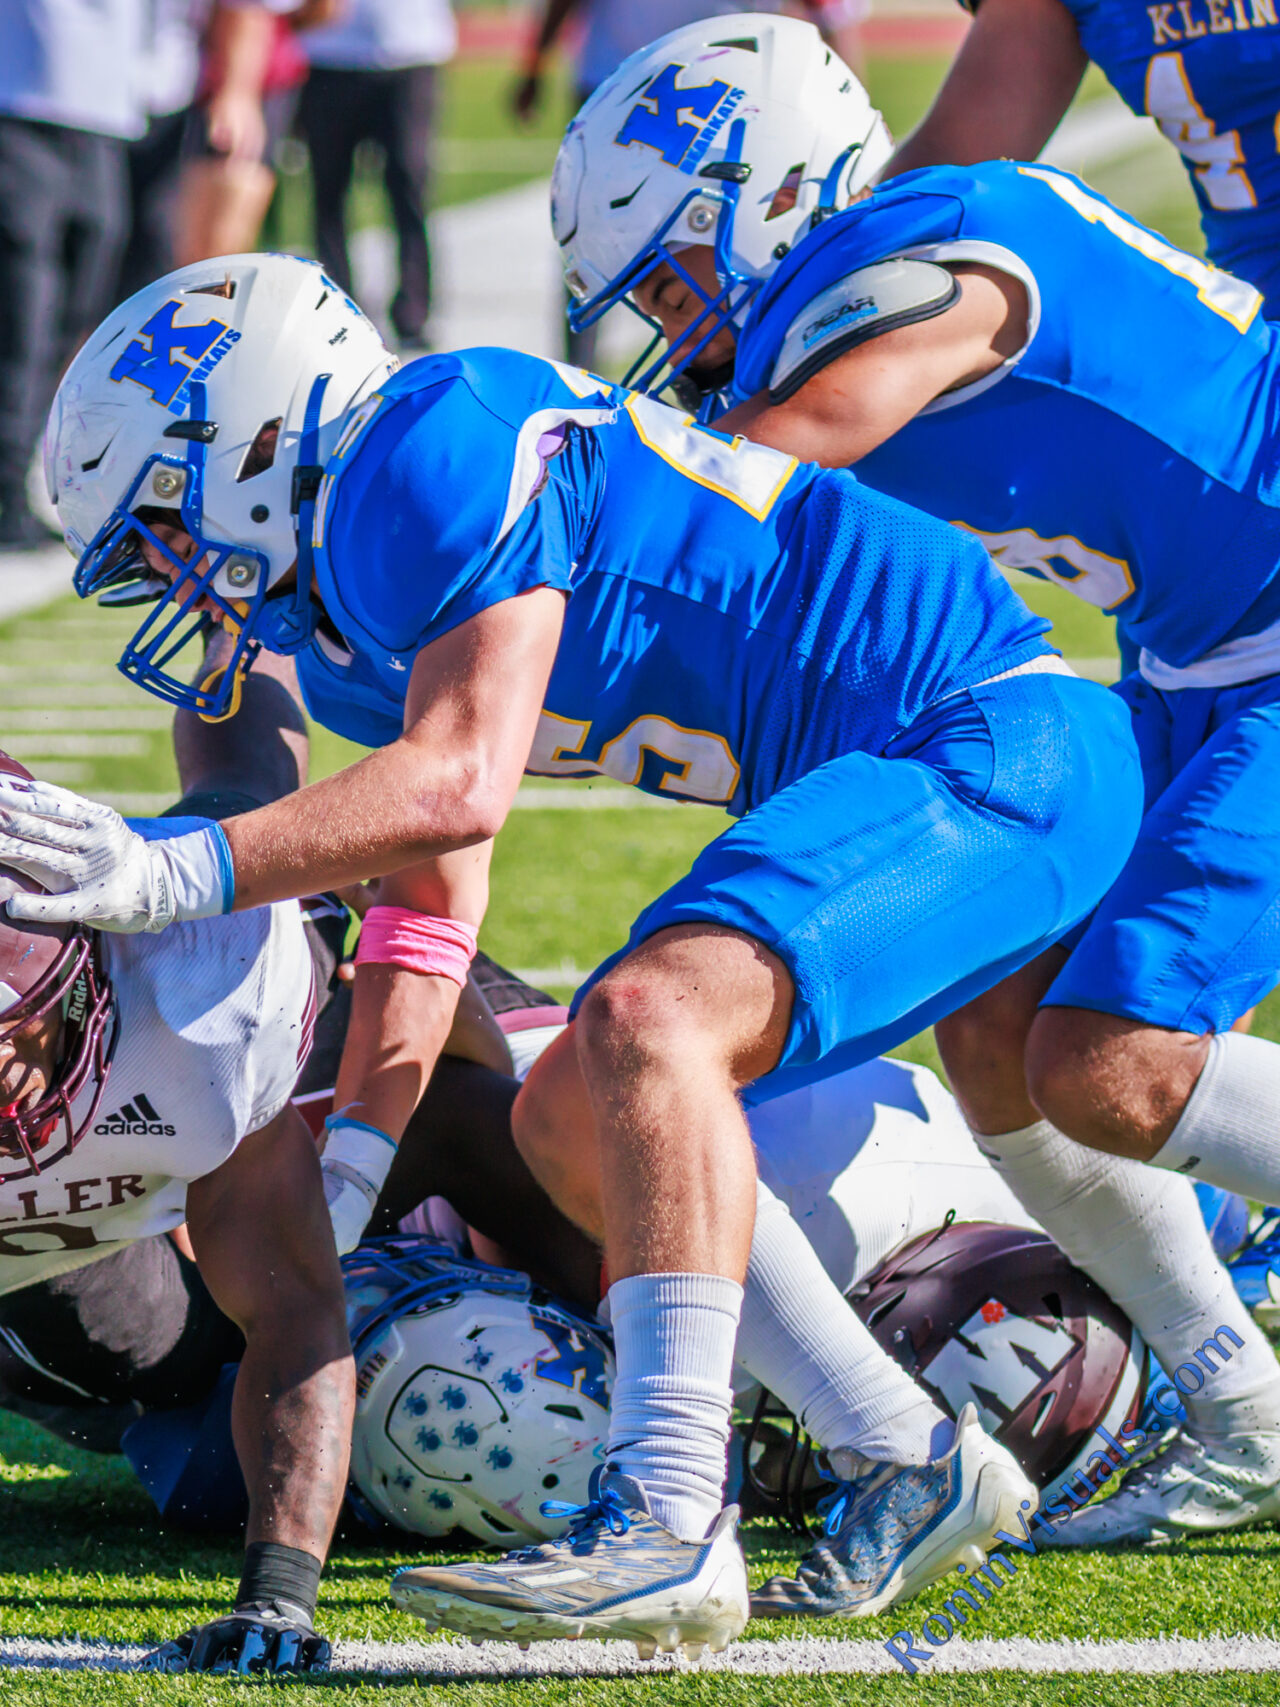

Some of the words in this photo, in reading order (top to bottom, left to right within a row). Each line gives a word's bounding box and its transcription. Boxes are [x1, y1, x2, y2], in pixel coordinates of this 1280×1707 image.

[1147, 0, 1278, 45] KLEIN
[613, 62, 732, 169] K
[678, 87, 746, 175] BEARKATS
[109, 298, 229, 409] K
[167, 328, 242, 416] BERKATS
[94, 1121, 176, 1136] adidas
